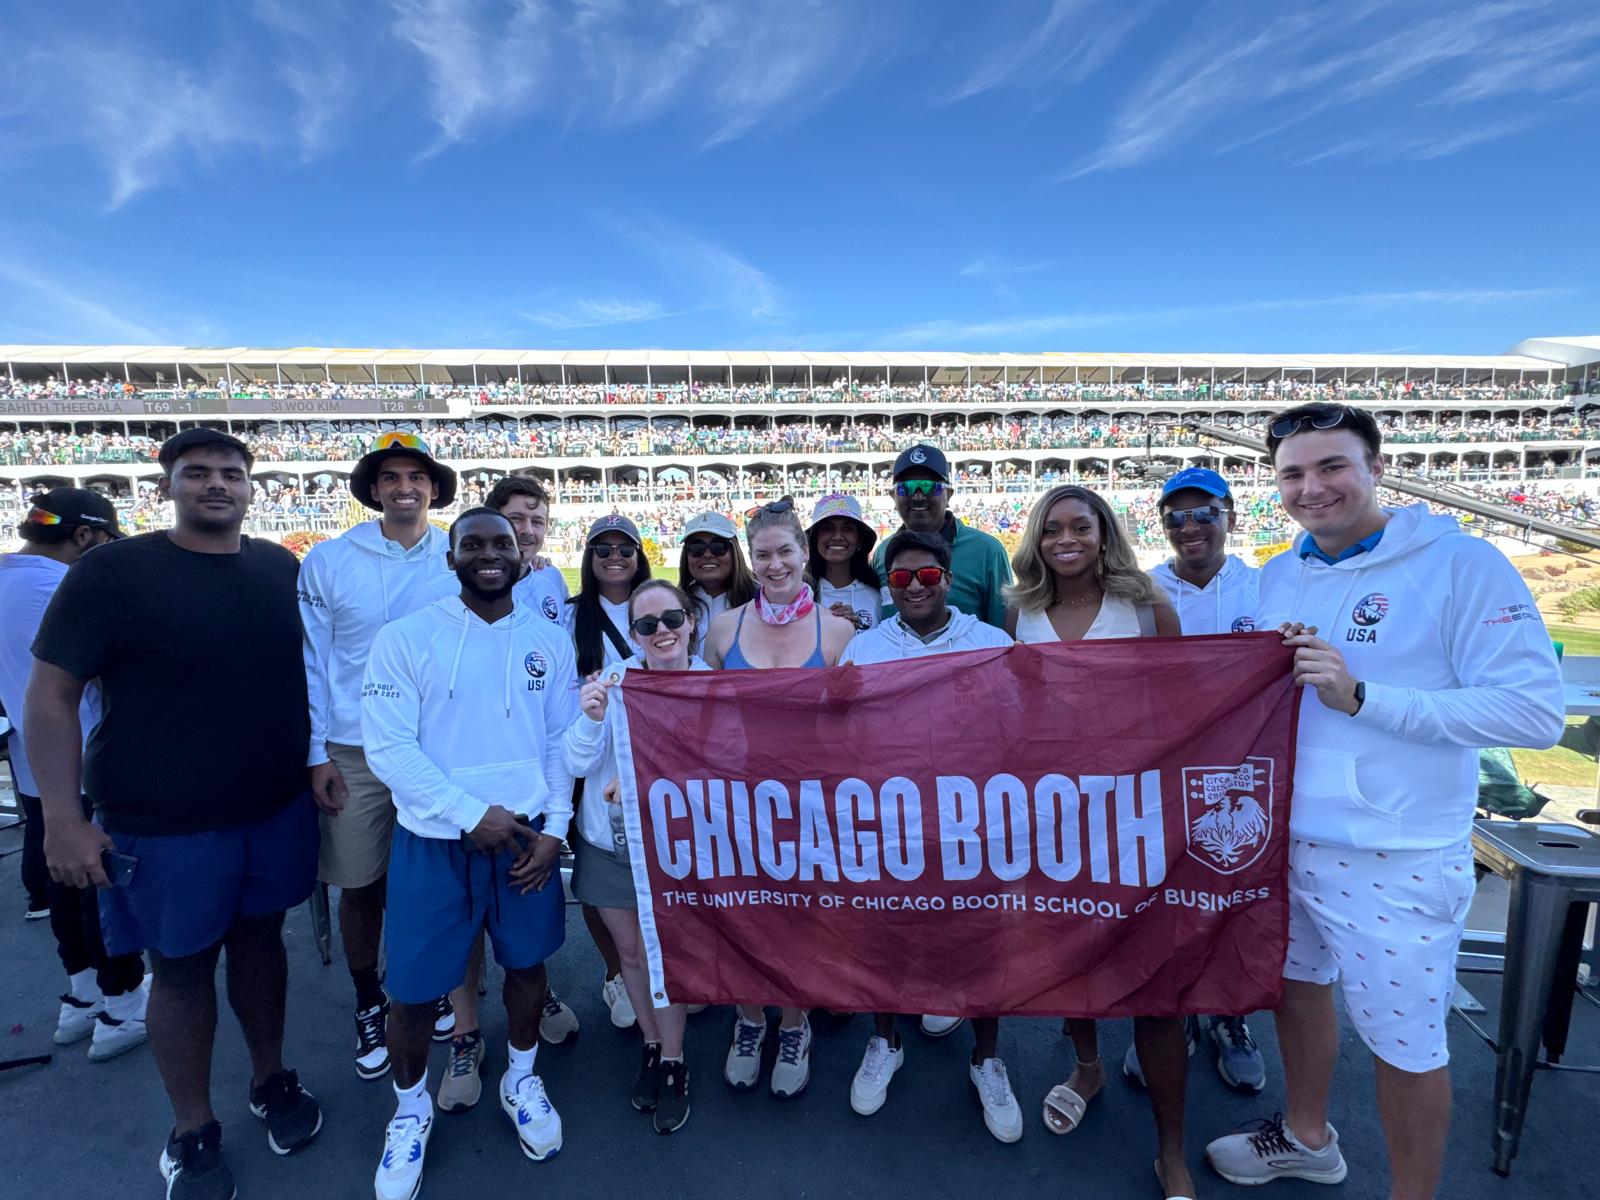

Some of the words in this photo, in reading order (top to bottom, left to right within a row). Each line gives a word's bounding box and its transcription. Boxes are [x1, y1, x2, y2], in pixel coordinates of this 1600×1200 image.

[0, 402, 49, 412] SAHITH
[51, 402, 122, 412] THEEGALA
[145, 402, 170, 412] T69
[271, 402, 282, 411] SI
[285, 402, 314, 411] WOO
[317, 402, 340, 411] KIM
[382, 402, 405, 412] T28
[1346, 628, 1377, 643] USA
[648, 776, 925, 883] CHICAGO
[936, 769, 1167, 887] BOOTH
[662, 891, 699, 906] THE
[703, 890, 811, 908] UNIVERSITY
[819, 895, 845, 908] OF
[852, 896, 946, 911] CHICAGO
[952, 894, 1027, 911] BOOTH
[1034, 895, 1129, 919] SCHOOL
[1165, 887, 1270, 911] BUSINESS
